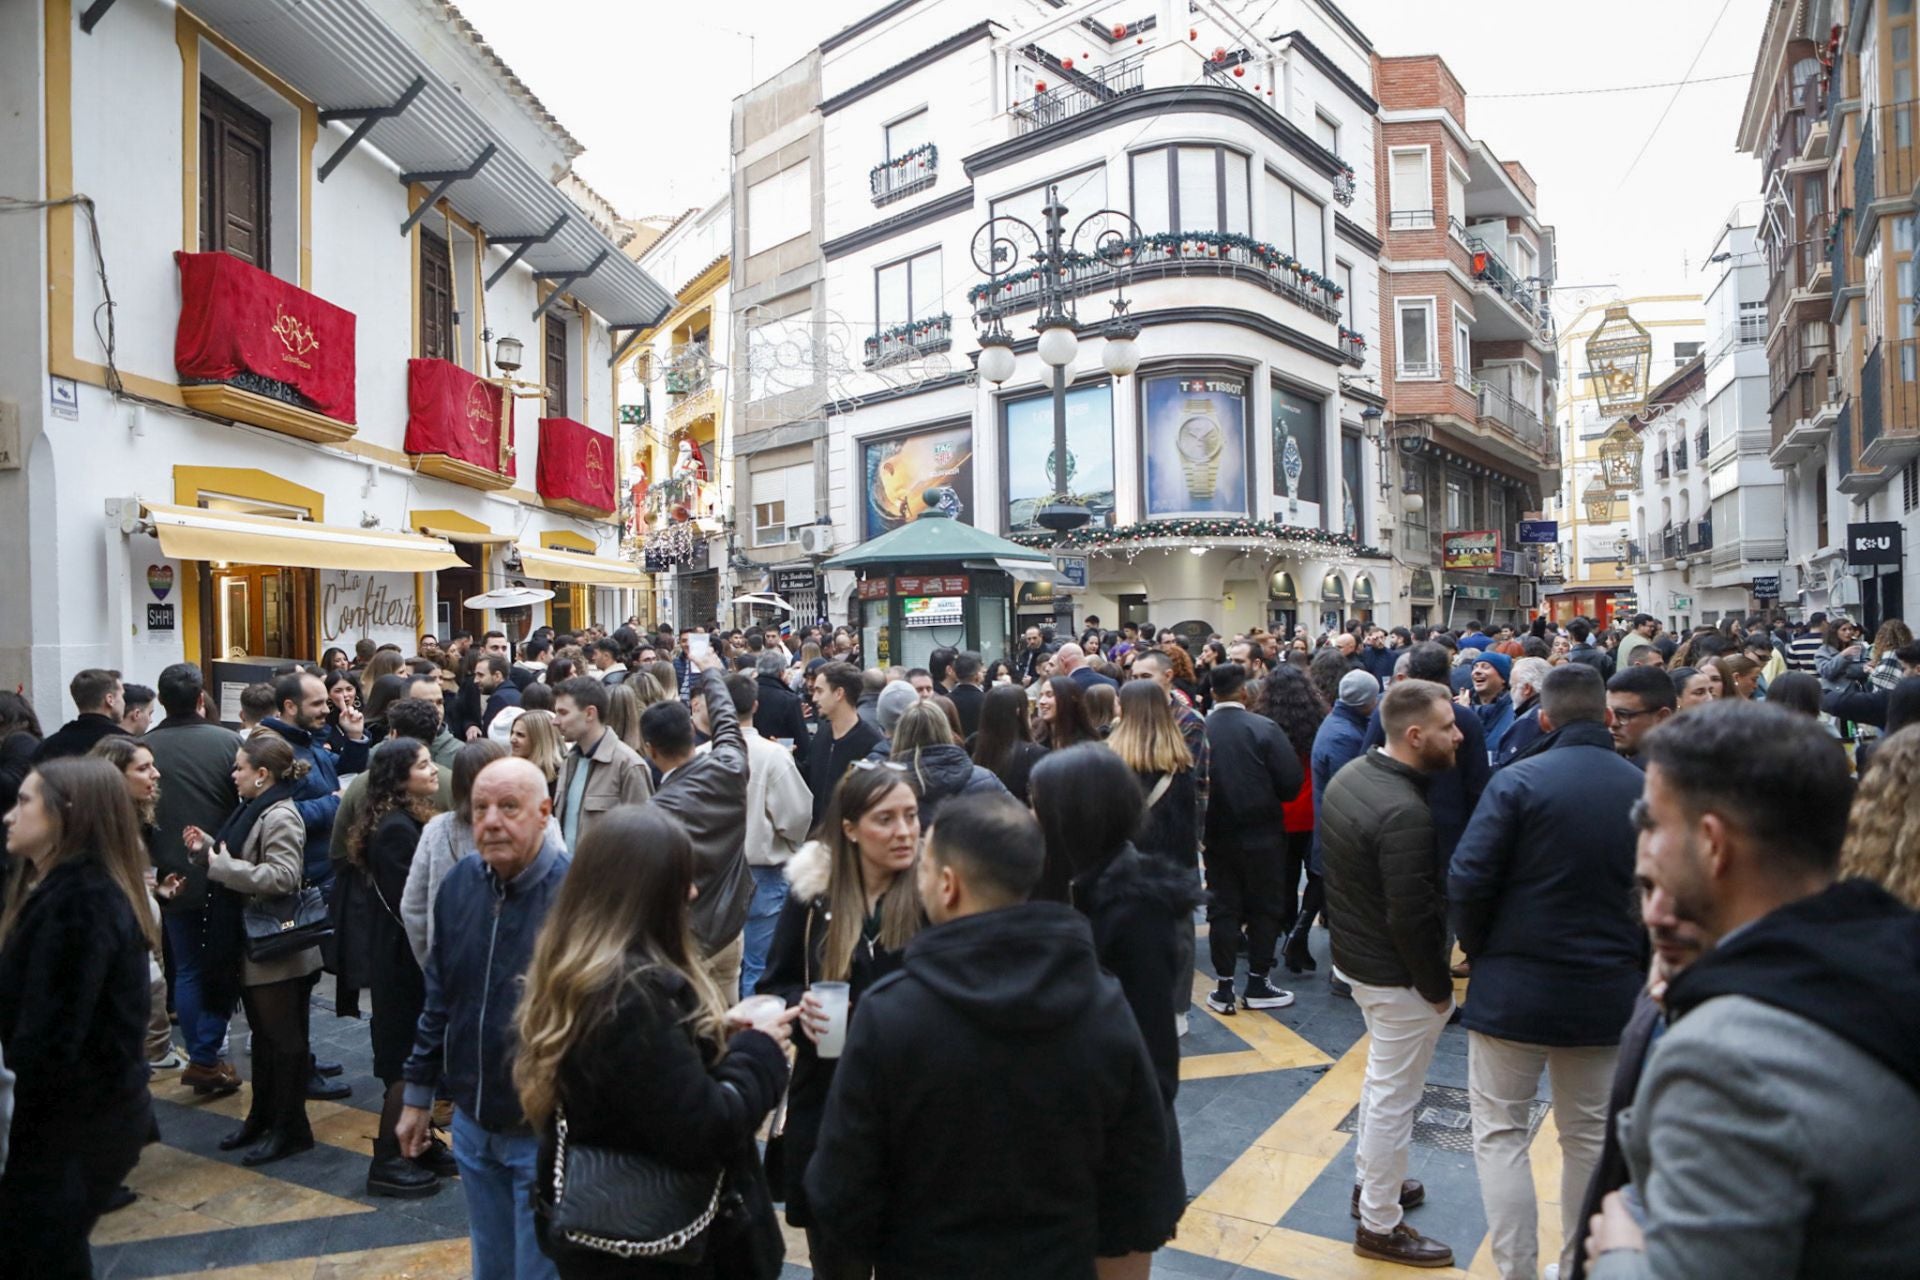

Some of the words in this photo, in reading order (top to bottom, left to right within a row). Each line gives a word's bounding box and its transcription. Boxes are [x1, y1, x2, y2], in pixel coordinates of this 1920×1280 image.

[1206, 382, 1242, 395] TISSOT
[1448, 547, 1492, 556] JUAN
[337, 569, 360, 592] La
[148, 609, 173, 626] SHH!
